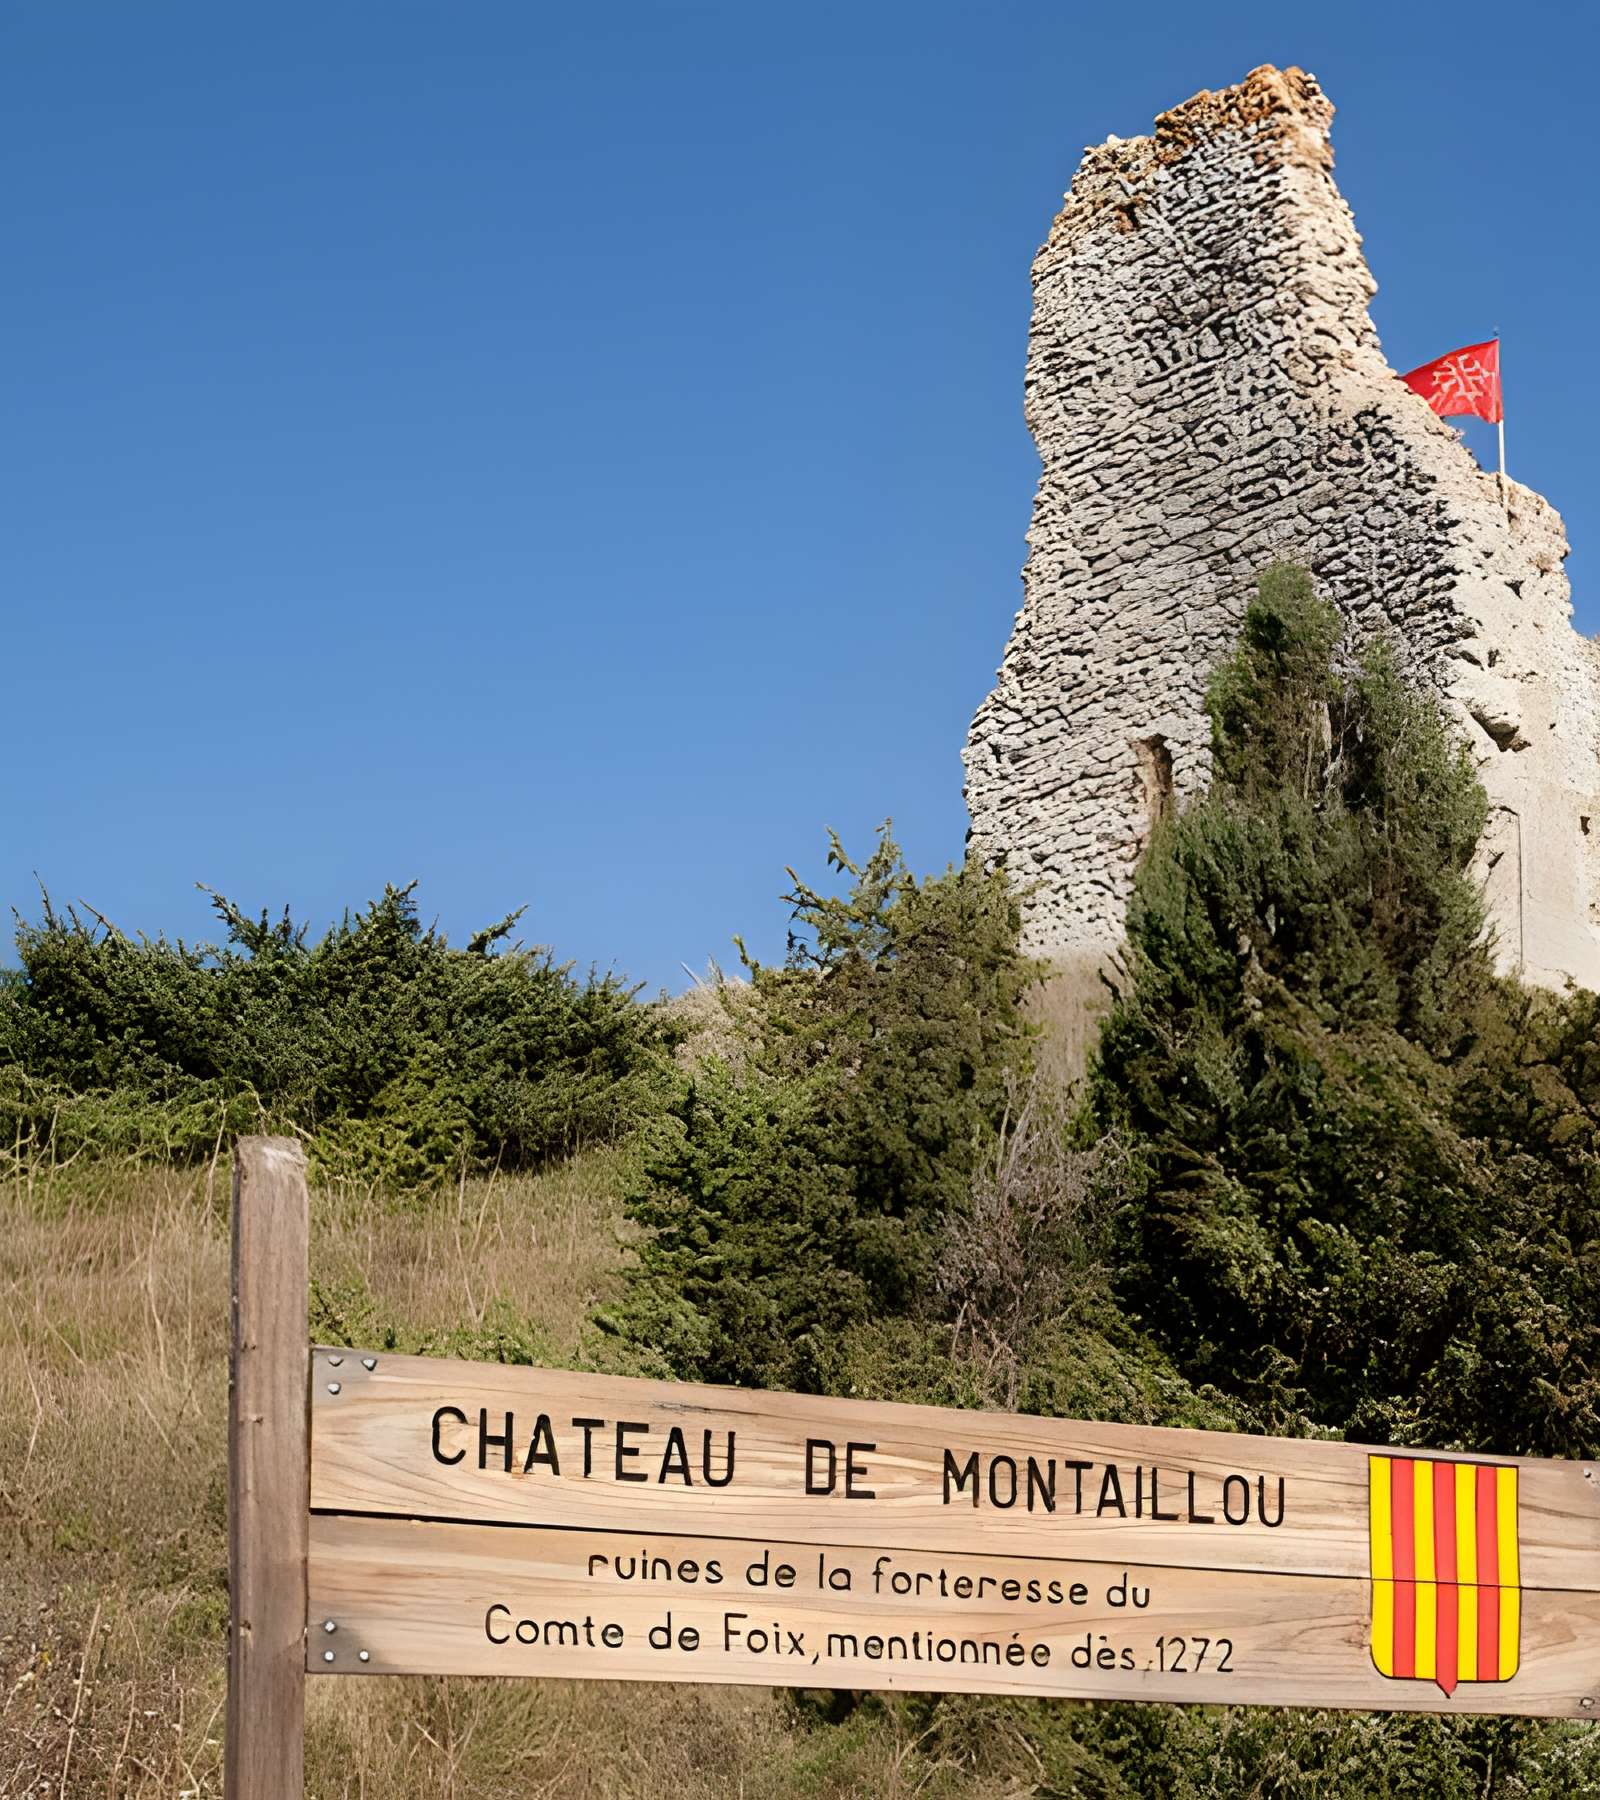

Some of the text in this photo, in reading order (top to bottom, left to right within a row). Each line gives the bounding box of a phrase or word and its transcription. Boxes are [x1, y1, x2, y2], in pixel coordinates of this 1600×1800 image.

[431, 1405, 1286, 1529] CHATEAU DE MONTAILLOU
[588, 1549, 1151, 1609] ruines de la forteresse du
[484, 1603, 625, 1650] Comte
[648, 1610, 701, 1652] de
